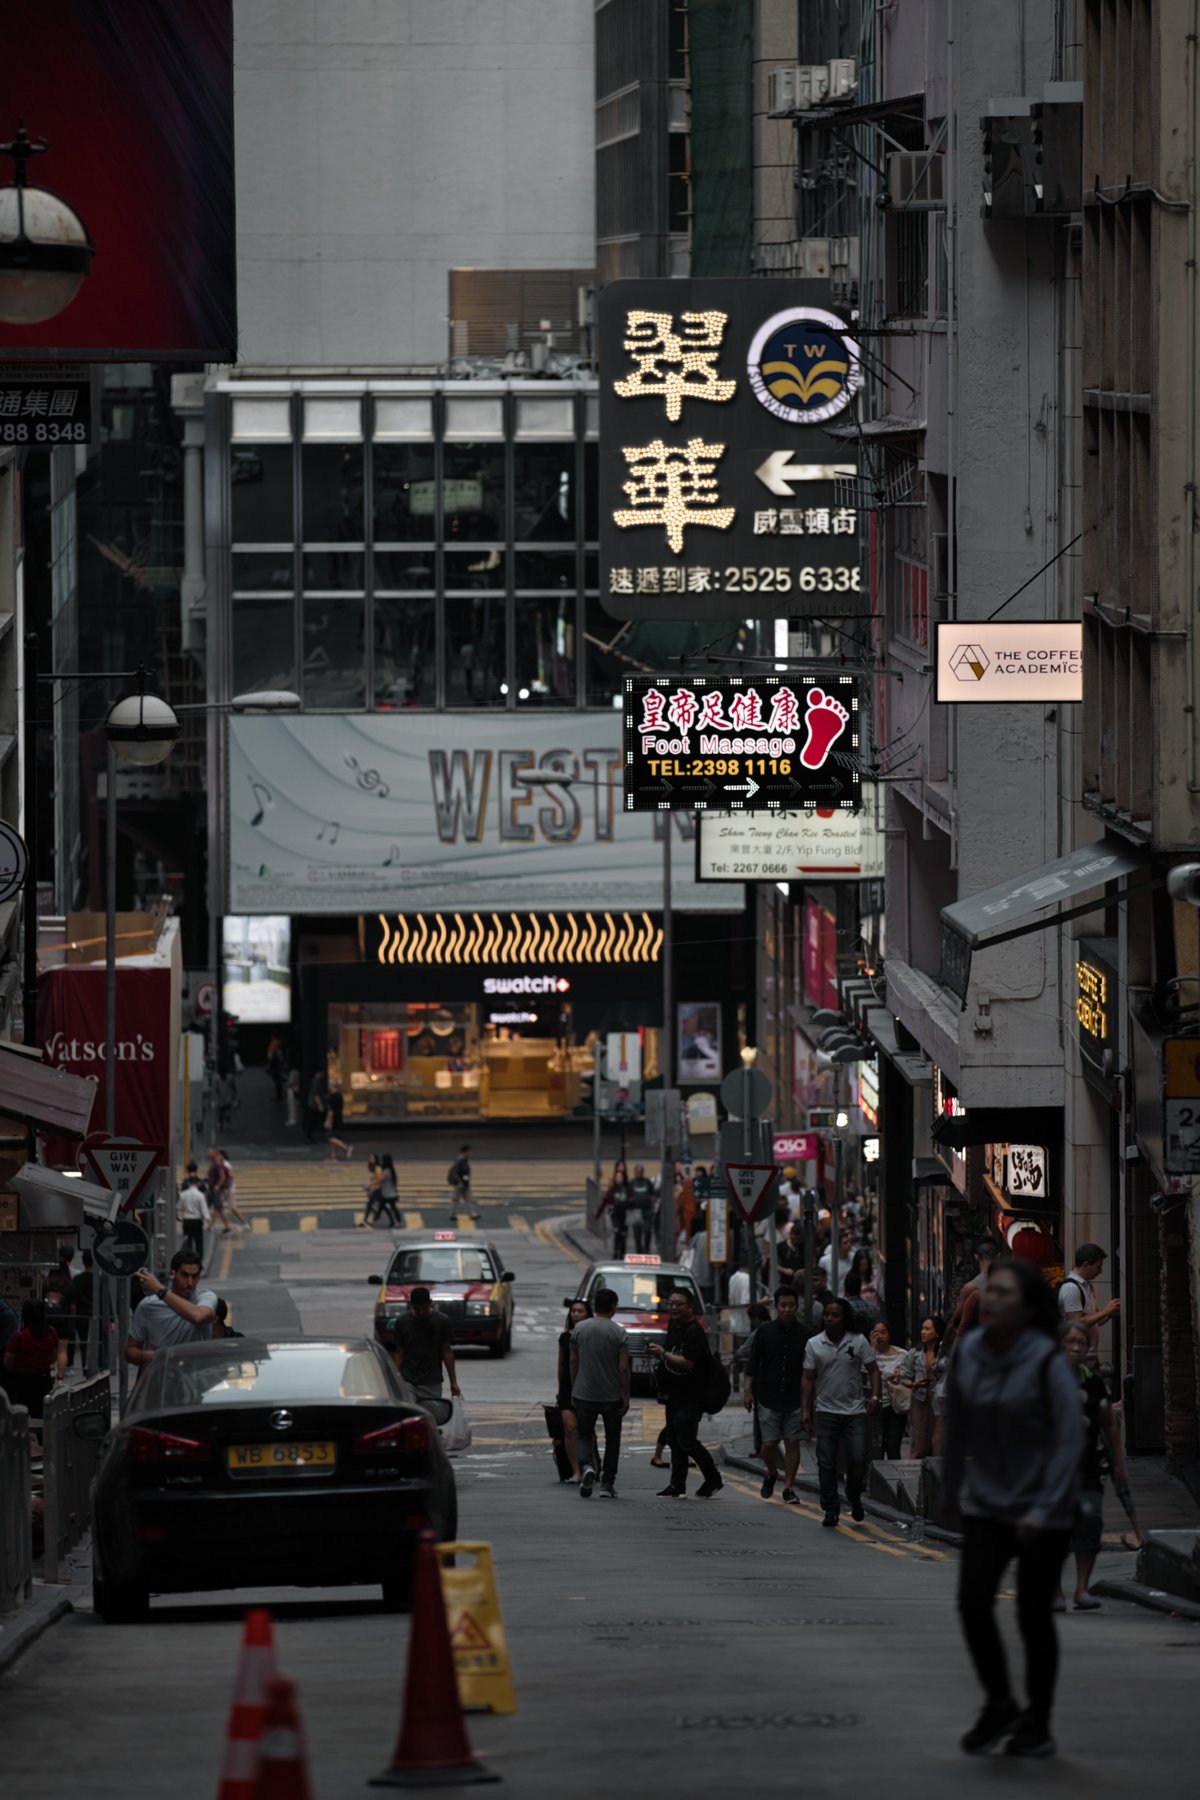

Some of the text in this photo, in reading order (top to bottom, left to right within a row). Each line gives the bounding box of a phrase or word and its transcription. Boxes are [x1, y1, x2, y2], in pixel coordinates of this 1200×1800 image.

[0, 422, 86, 441] 88 8348
[995, 651, 1022, 661] THE
[638, 687, 801, 735] 皇帝足健康
[641, 733, 797, 760] Foot Massage
[744, 759, 792, 776] 1116
[428, 747, 624, 843] WEST
[816, 844, 842, 858] Fung
[733, 863, 758, 874] 2267
[761, 863, 788, 874] 0666
[483, 975, 558, 994] swatch
[110, 1151, 138, 1161] GIVE
[111, 1163, 137, 1173] WAY
[236, 1443, 329, 1464] WB 6853
